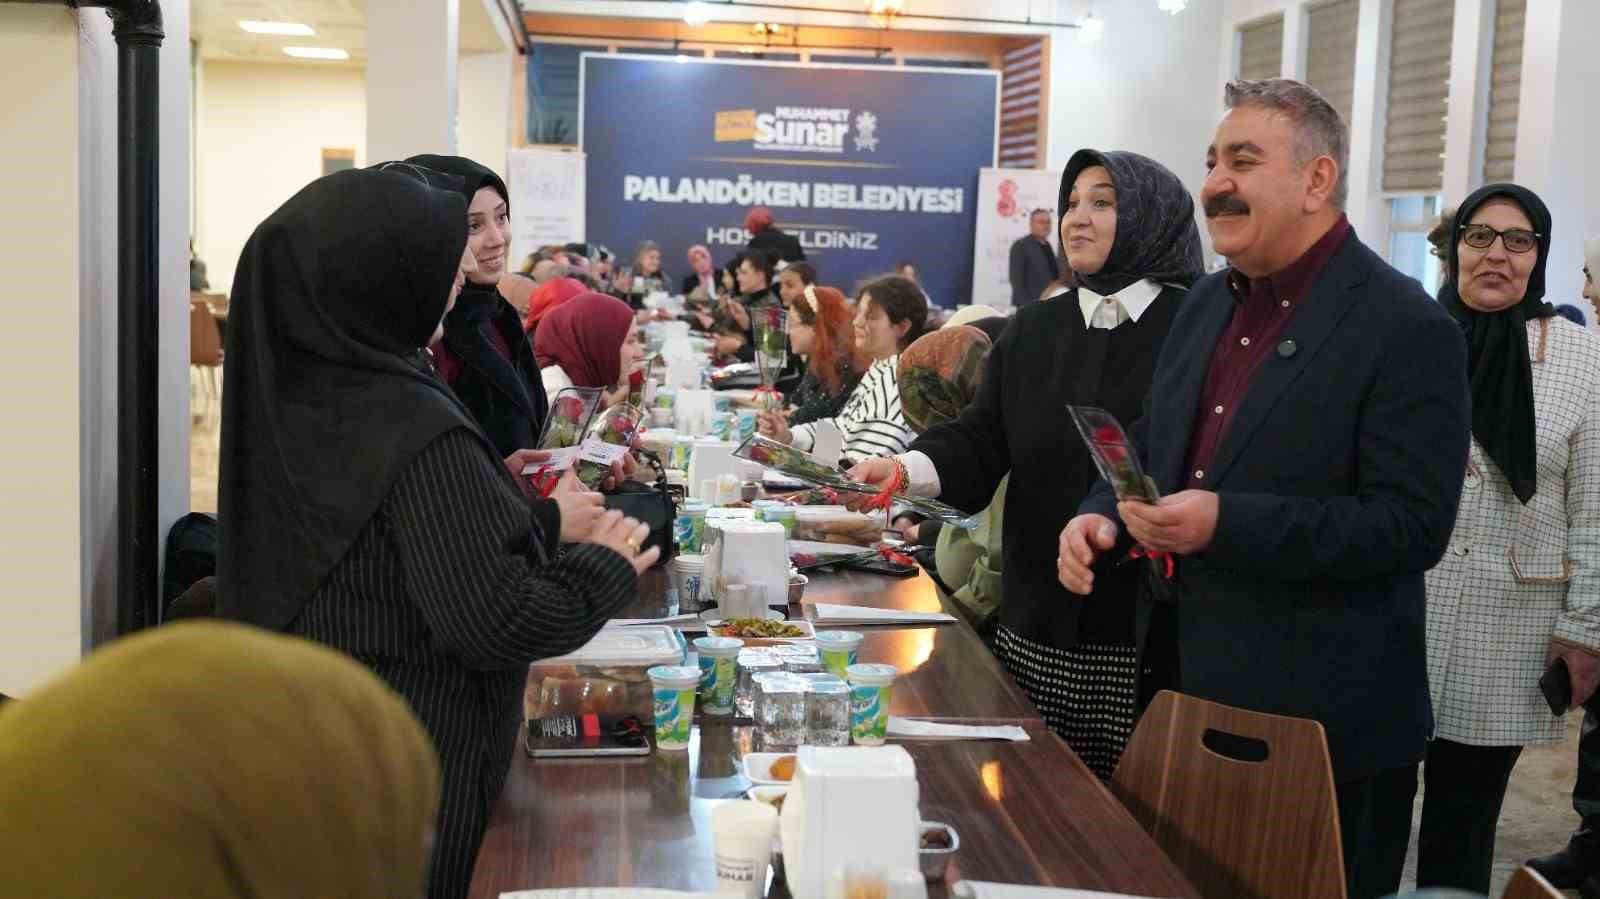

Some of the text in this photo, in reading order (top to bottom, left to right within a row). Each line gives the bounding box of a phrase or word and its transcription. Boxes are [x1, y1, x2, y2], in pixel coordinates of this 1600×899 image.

[754, 113, 849, 147] Sunar
[623, 174, 964, 213] PALANDÖKEN BELEDİYESİ
[783, 230, 878, 250] LDİNİZ
